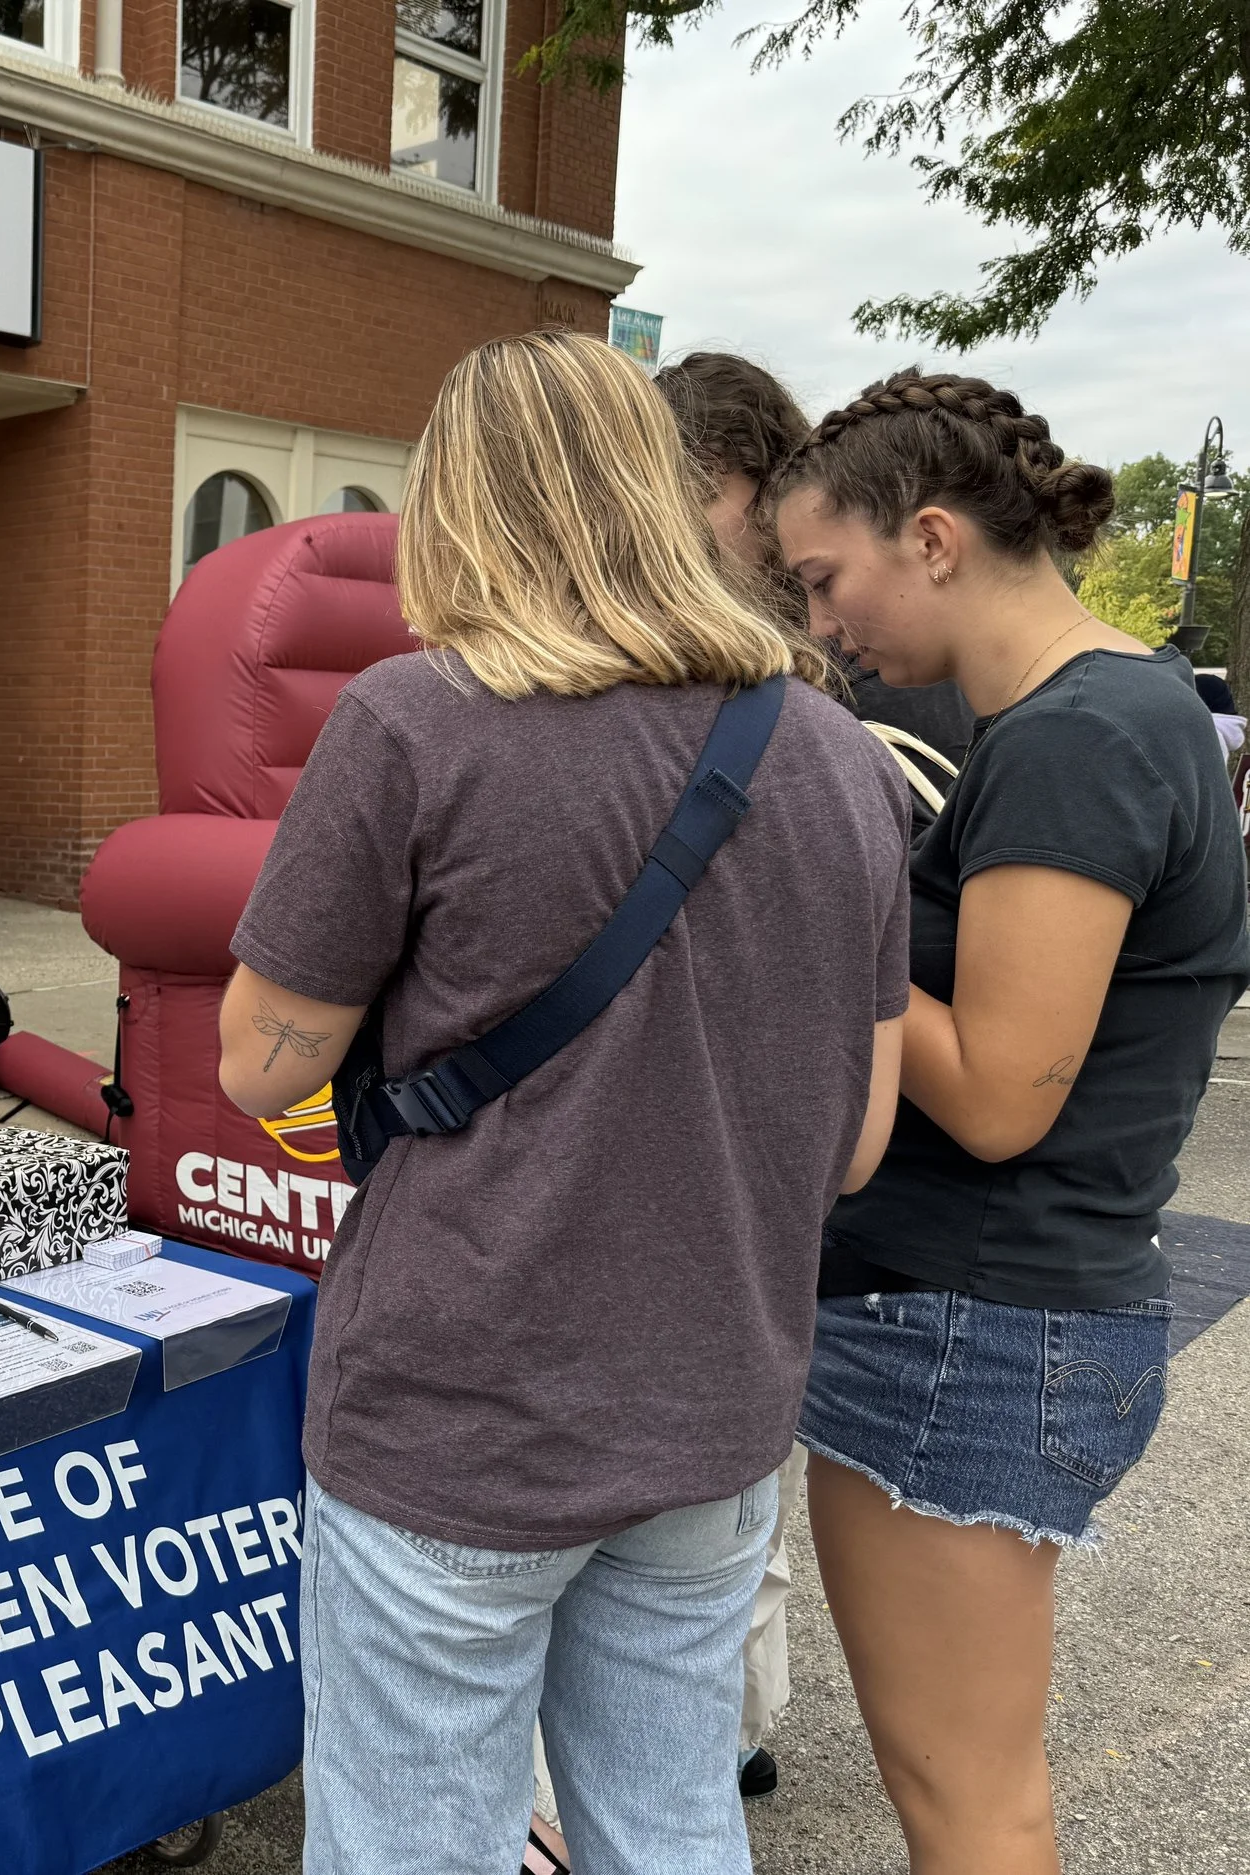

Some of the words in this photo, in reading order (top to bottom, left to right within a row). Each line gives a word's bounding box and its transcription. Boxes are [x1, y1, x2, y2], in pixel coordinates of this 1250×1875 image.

[178, 1203, 294, 1255] MICHIGAN
[53, 1440, 148, 1519] OF
[92, 1490, 303, 1608] VOTER
